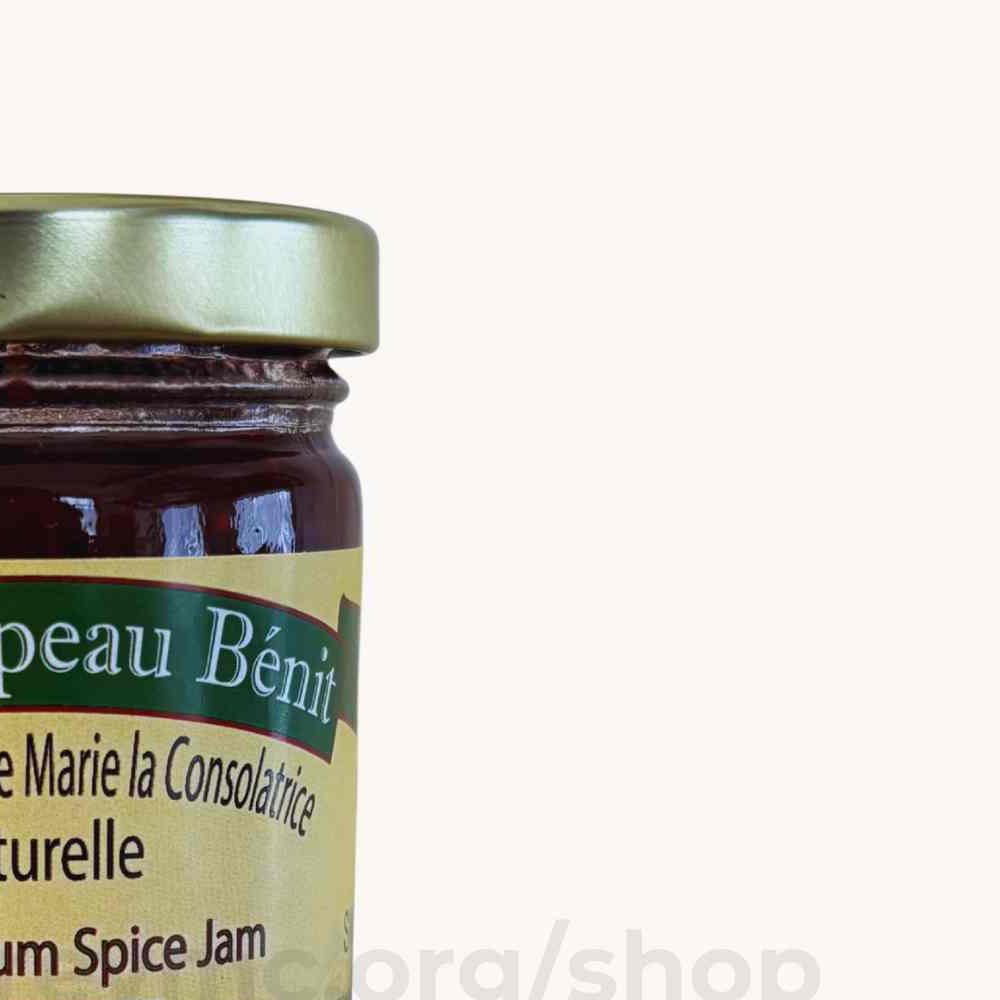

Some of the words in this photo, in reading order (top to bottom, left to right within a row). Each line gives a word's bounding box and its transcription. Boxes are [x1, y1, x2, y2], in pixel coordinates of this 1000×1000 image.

[194, 604, 338, 727] Bénit
[25, 731, 121, 798] Marie
[128, 729, 157, 797] la
[165, 734, 318, 839] Consolatrice
[73, 923, 188, 988] Spice
[196, 918, 267, 969] Jam
